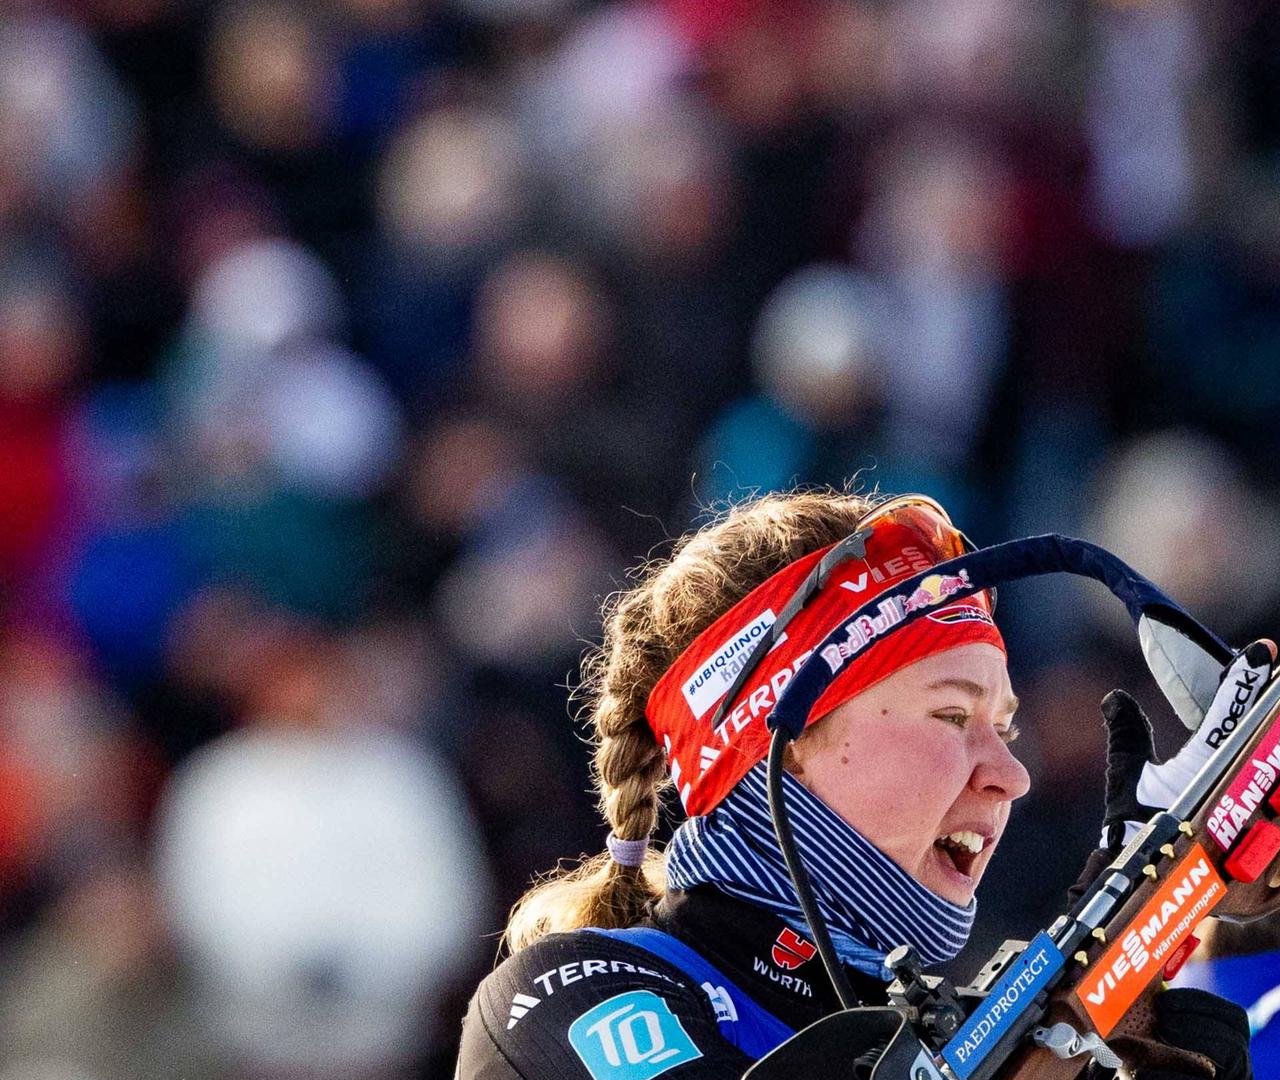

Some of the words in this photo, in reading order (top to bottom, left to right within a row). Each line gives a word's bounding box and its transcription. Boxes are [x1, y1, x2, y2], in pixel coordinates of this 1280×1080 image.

[687, 620, 772, 696] #UBIQUINOL
[1207, 794, 1235, 835] DAS
[1086, 858, 1211, 1006] VIESSMANN
[1152, 881, 1221, 961] Wärmepumpen
[586, 1003, 681, 1067] TQ
[955, 948, 1050, 1063] PAEDIPROTECT
